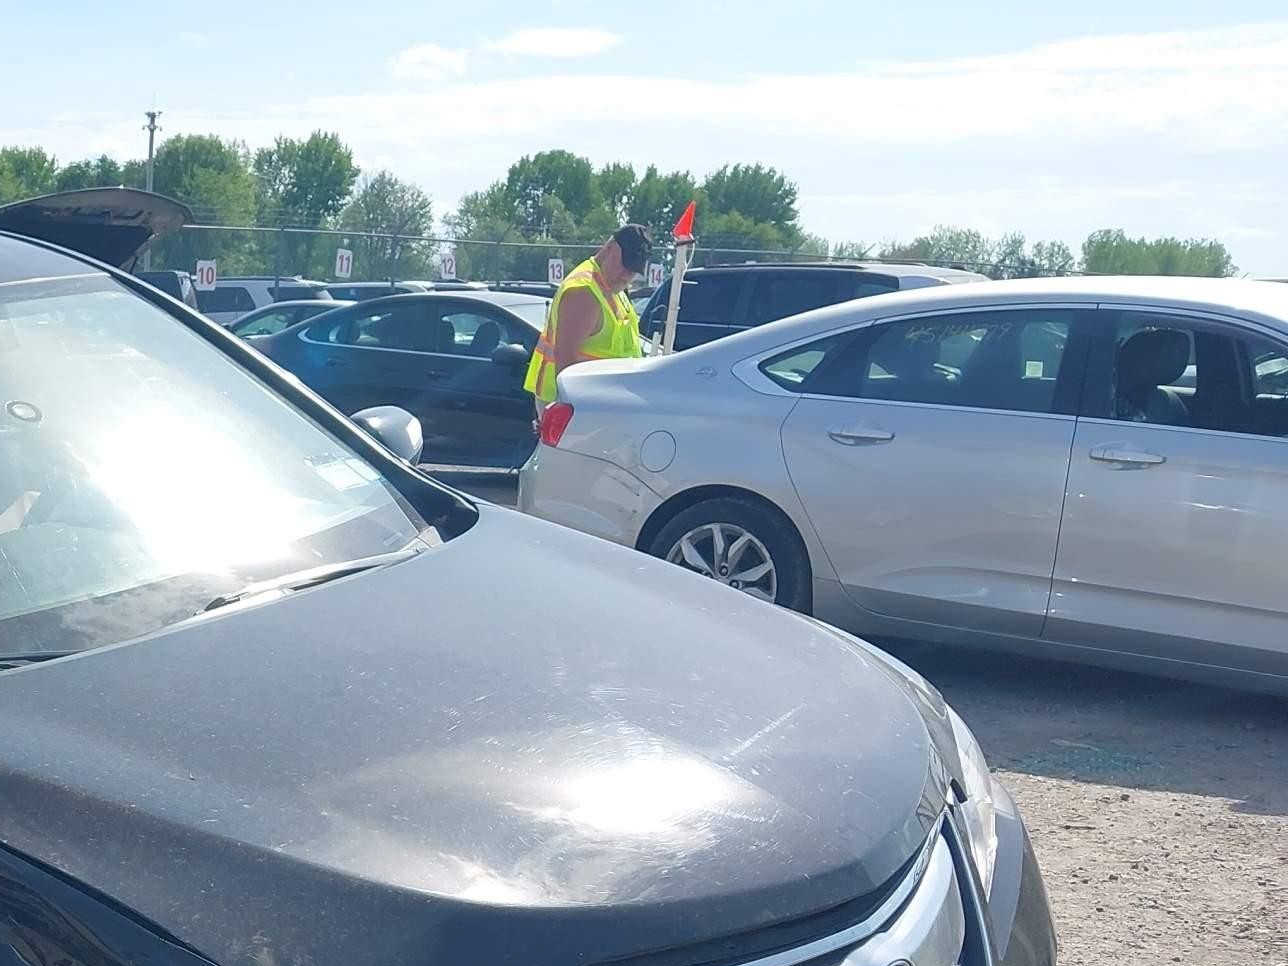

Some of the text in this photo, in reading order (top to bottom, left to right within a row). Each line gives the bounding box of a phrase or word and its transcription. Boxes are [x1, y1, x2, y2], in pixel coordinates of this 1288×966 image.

[338, 255, 350, 273] 11
[442, 258, 454, 275] 12
[550, 263, 562, 280] 13
[198, 267, 214, 285] 10
[651, 268, 661, 284] 14
